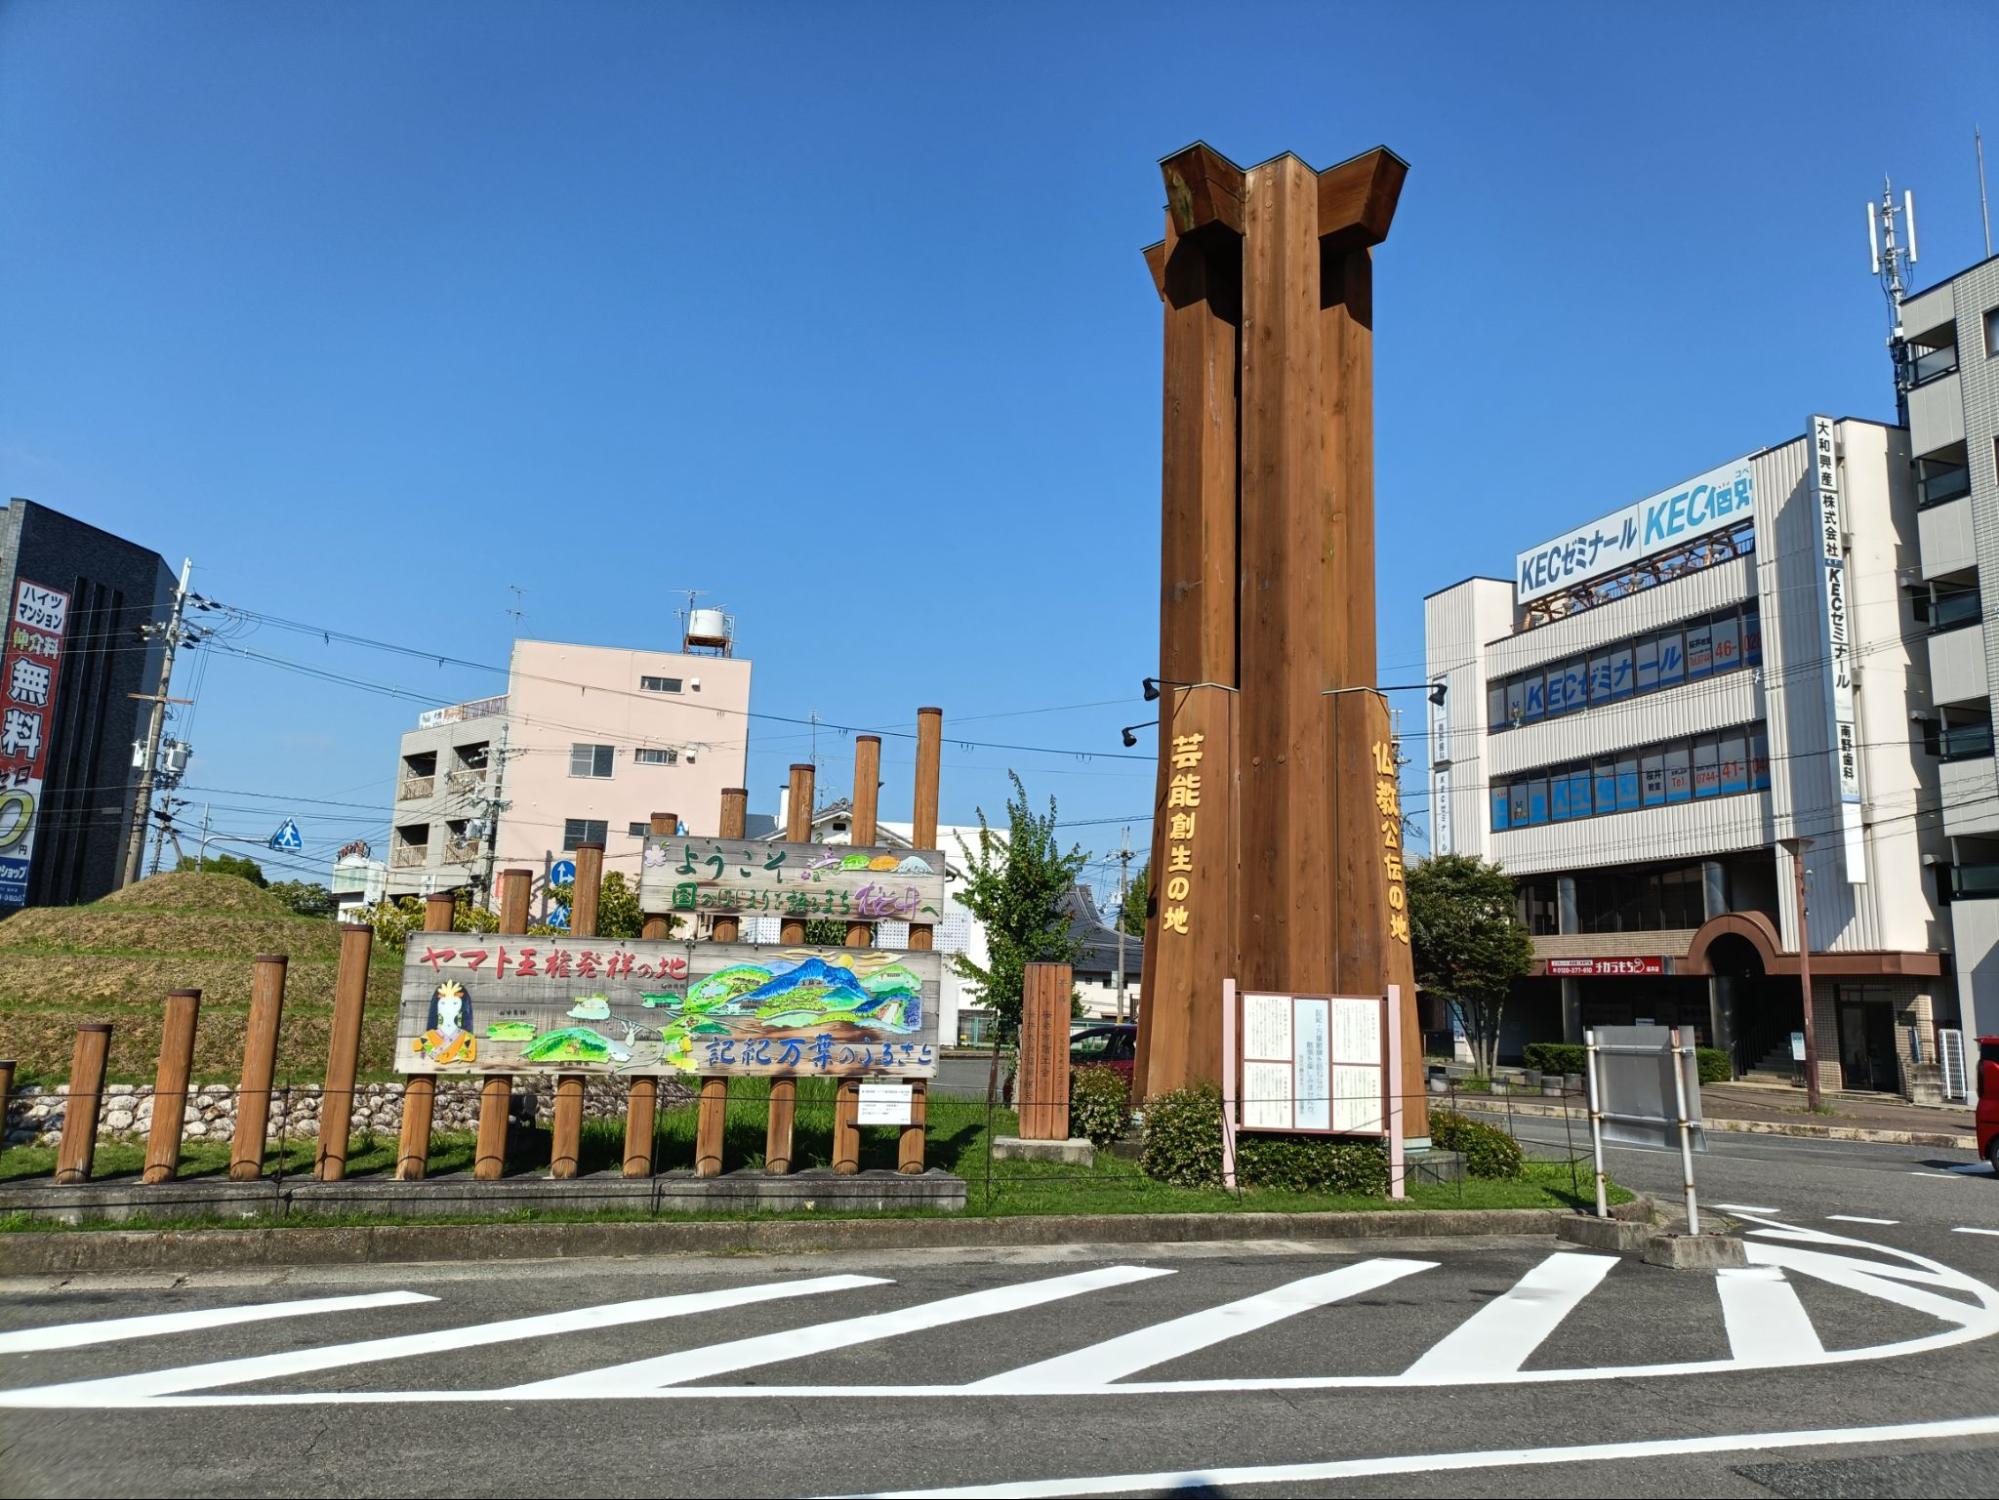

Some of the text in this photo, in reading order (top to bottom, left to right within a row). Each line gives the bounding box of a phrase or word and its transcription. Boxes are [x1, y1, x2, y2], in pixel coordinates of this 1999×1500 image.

[1817, 421, 1839, 557] 大和興産株式会社
[1521, 517, 1638, 594] KECゼミナール
[19, 603, 62, 629] マンション
[24, 586, 63, 609] ハイツ
[13, 627, 59, 660] 仲介料
[1829, 569, 1850, 688] KECゼミナール
[1527, 646, 1682, 712] KECゼミナール
[2, 660, 50, 761] 無料
[1840, 725, 1854, 779] 南野歯科
[675, 844, 787, 884] ようこそ
[1163, 733, 1204, 935] 芸能創生の地
[1372, 741, 1408, 945] 仏教公伝の地
[420, 945, 688, 980] ヤマト王権発祥の地
[705, 1034, 933, 1070] 記紀万葉のふるさと
